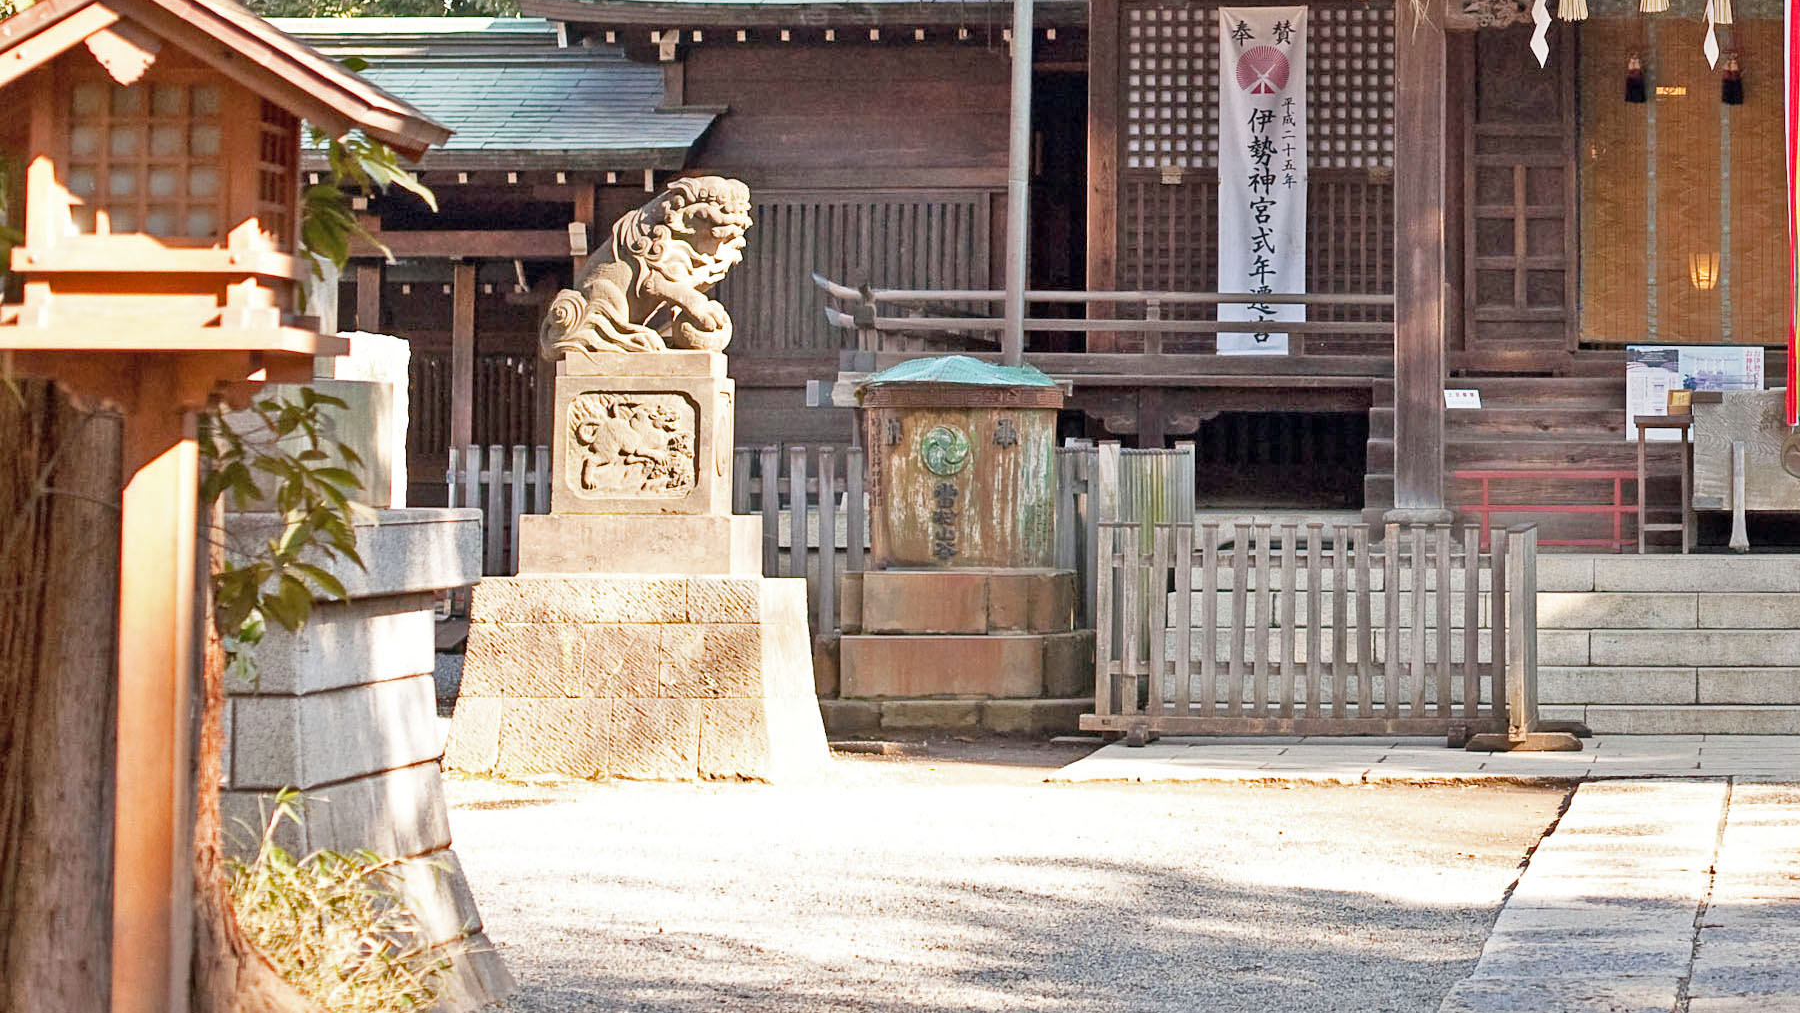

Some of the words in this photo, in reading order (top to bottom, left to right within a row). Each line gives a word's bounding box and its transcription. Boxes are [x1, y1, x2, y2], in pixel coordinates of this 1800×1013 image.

[1281, 96, 1297, 190] 平成二十五年
